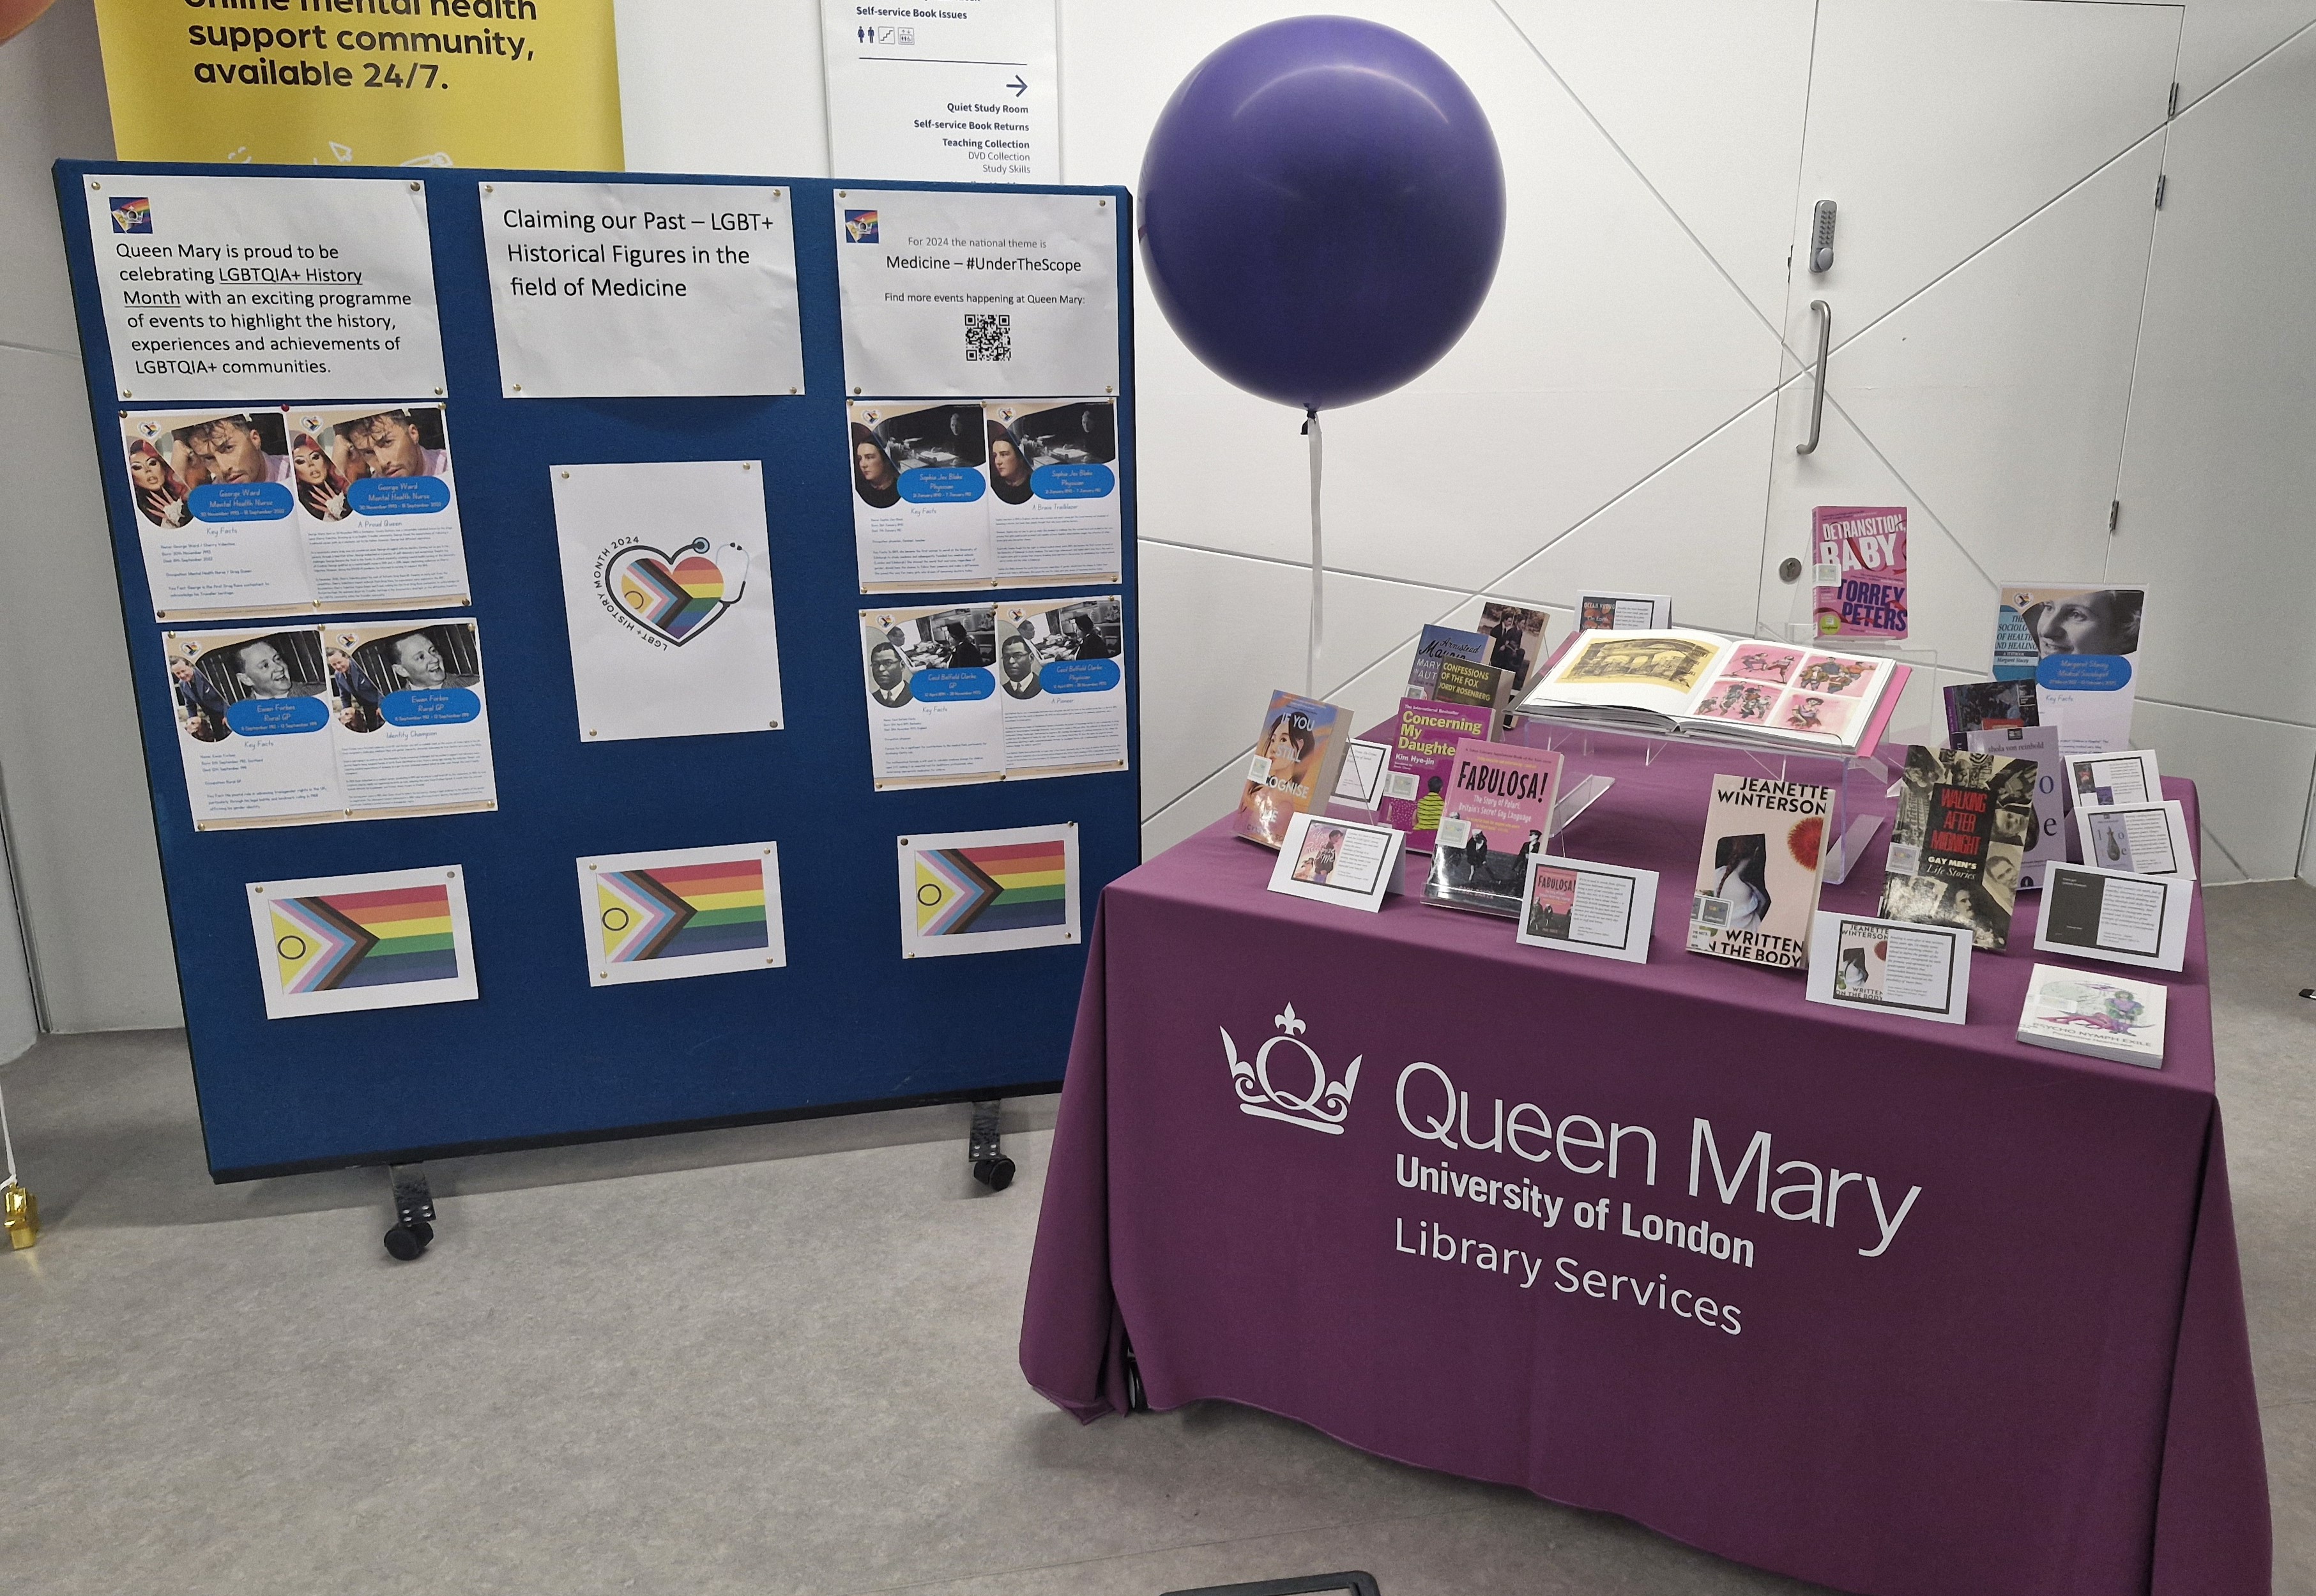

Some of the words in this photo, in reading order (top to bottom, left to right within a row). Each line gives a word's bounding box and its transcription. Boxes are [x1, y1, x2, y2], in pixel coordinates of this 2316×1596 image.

[431, 0, 537, 20] health
[857, 6, 910, 17] Self-service
[913, 9, 936, 17] Book
[940, 10, 967, 19] Issues
[189, 26, 327, 52] support
[337, 28, 533, 61] community,
[194, 57, 353, 86] available
[363, 63, 448, 89] 24/7.
[947, 103, 971, 112] Quiet
[975, 104, 1000, 114] Study
[914, 119, 966, 129] Self-service
[994, 123, 1029, 131] Returns
[943, 139, 982, 149] Teaching
[985, 140, 1029, 148] Collection
[988, 152, 1030, 161] Collection
[983, 165, 1006, 174] Study
[1009, 165, 1030, 174] Skills
[504, 209, 595, 232] Claiming
[602, 216, 637, 229] our
[644, 212, 686, 229] Past
[712, 213, 773, 231] LGBT+
[908, 237, 923, 245] For
[926, 238, 948, 246] 2024
[952, 238, 966, 247] the
[970, 239, 1005, 247] national
[1009, 239, 1037, 248] theme
[116, 243, 172, 258] Queen
[178, 244, 220, 261] Mary
[226, 244, 238, 257] is
[244, 245, 292, 261] proud
[297, 247, 314, 258] to
[319, 245, 338, 259] be
[508, 244, 604, 262] Historical
[613, 245, 685, 267] Figures
[692, 246, 710, 263] in
[716, 245, 749, 264] the
[887, 255, 950, 269] Medicine
[966, 257, 1081, 274] #UnderTheScope
[120, 268, 215, 283] celebrating
[220, 268, 301, 283] LGBTQIA+
[307, 269, 362, 284] History
[510, 277, 556, 296] field
[564, 277, 584, 296] of
[592, 278, 686, 296] Medicine
[124, 291, 180, 305] Month
[185, 291, 221, 305] with
[227, 294, 246, 305] an
[252, 292, 314, 307] exciting
[319, 293, 411, 308] programme
[885, 293, 904, 301] Find
[967, 293, 1014, 305] happening
[1028, 295, 1056, 303] Queen
[1060, 295, 1085, 305] Mary:
[128, 314, 144, 328] of
[149, 315, 204, 328] events
[209, 315, 225, 327] to
[231, 314, 301, 330] highlight
[306, 314, 332, 327] the
[337, 314, 395, 330] history,
[132, 338, 230, 354] experiences
[235, 337, 264, 350] and
[271, 337, 379, 350] achievements
[385, 337, 400, 350] of
[136, 360, 217, 374] LGBTQIA+
[223, 361, 330, 373] communities.
[911, 508, 920, 517] Key
[1823, 514, 1906, 542] DETRANSITION,
[611, 536, 639, 549] 2024
[1820, 533, 1896, 571] BABY
[594, 548, 611, 588] MONTH
[1837, 579, 1905, 607] TORREY
[597, 593, 634, 632] HISTORY
[1842, 602, 1907, 632] PETERS
[636, 629, 668, 651] LGBT+
[1440, 637, 1481, 653] Armistead
[1417, 659, 1441, 669] MARY
[1444, 663, 1489, 680] CONFESSIONS
[1451, 674, 1463, 684] THE
[1465, 678, 1479, 688] FOX
[1438, 682, 1458, 692] JORDY
[1456, 687, 1490, 701] ROSENBERG
[1281, 712, 1291, 723] IF
[1293, 715, 1314, 731] YOU
[1403, 711, 1482, 734] Concerning
[386, 731, 408, 740] Identity
[1403, 724, 1422, 740] My
[245, 741, 255, 750] Key
[1276, 745, 1301, 763] STILL
[1398, 737, 1456, 756] Daughte
[2019, 742, 2043, 750] reinhold
[1396, 753, 1408, 761] Kim
[1410, 756, 1435, 765] Hye-jin
[1457, 761, 1548, 803] FABULOSA!
[1740, 777, 1828, 800] JEANETTE
[1484, 797, 1497, 807] Story
[1718, 789, 1826, 815] WINTERSON
[1941, 788, 1987, 812] WALKING
[1459, 803, 1479, 812] Britain's
[1481, 806, 1497, 815] Secret
[1498, 809, 1506, 817] Gay
[1508, 810, 1532, 823] Language
[1943, 812, 1976, 832] AFTER
[1931, 829, 1980, 855] MIDNIGHT
[1928, 856, 1947, 865] GAY
[1948, 858, 1977, 870] MEN'S
[1926, 865, 1944, 876] Life
[1947, 867, 1976, 880] Stories
[1538, 875, 1576, 893] FABULOSA!
[1841, 930, 1888, 940] WINTERSON
[1850, 925, 1889, 934] JEANETTE
[1726, 930, 1804, 953] WRITTEN
[1721, 942, 1751, 959] THE
[1756, 947, 1801, 967] BODY
[2034, 1023, 2075, 1034] PSYCHO
[2079, 1033, 2119, 1041] NYMPH
[1396, 1062, 1656, 1197] Queen
[1687, 1118, 1922, 1268] Mary
[1397, 1154, 1564, 1227] University
[1574, 1199, 1610, 1230] of
[1622, 1203, 1753, 1268] London
[1397, 1218, 1542, 1288] Library
[1555, 1258, 1741, 1335] Services
